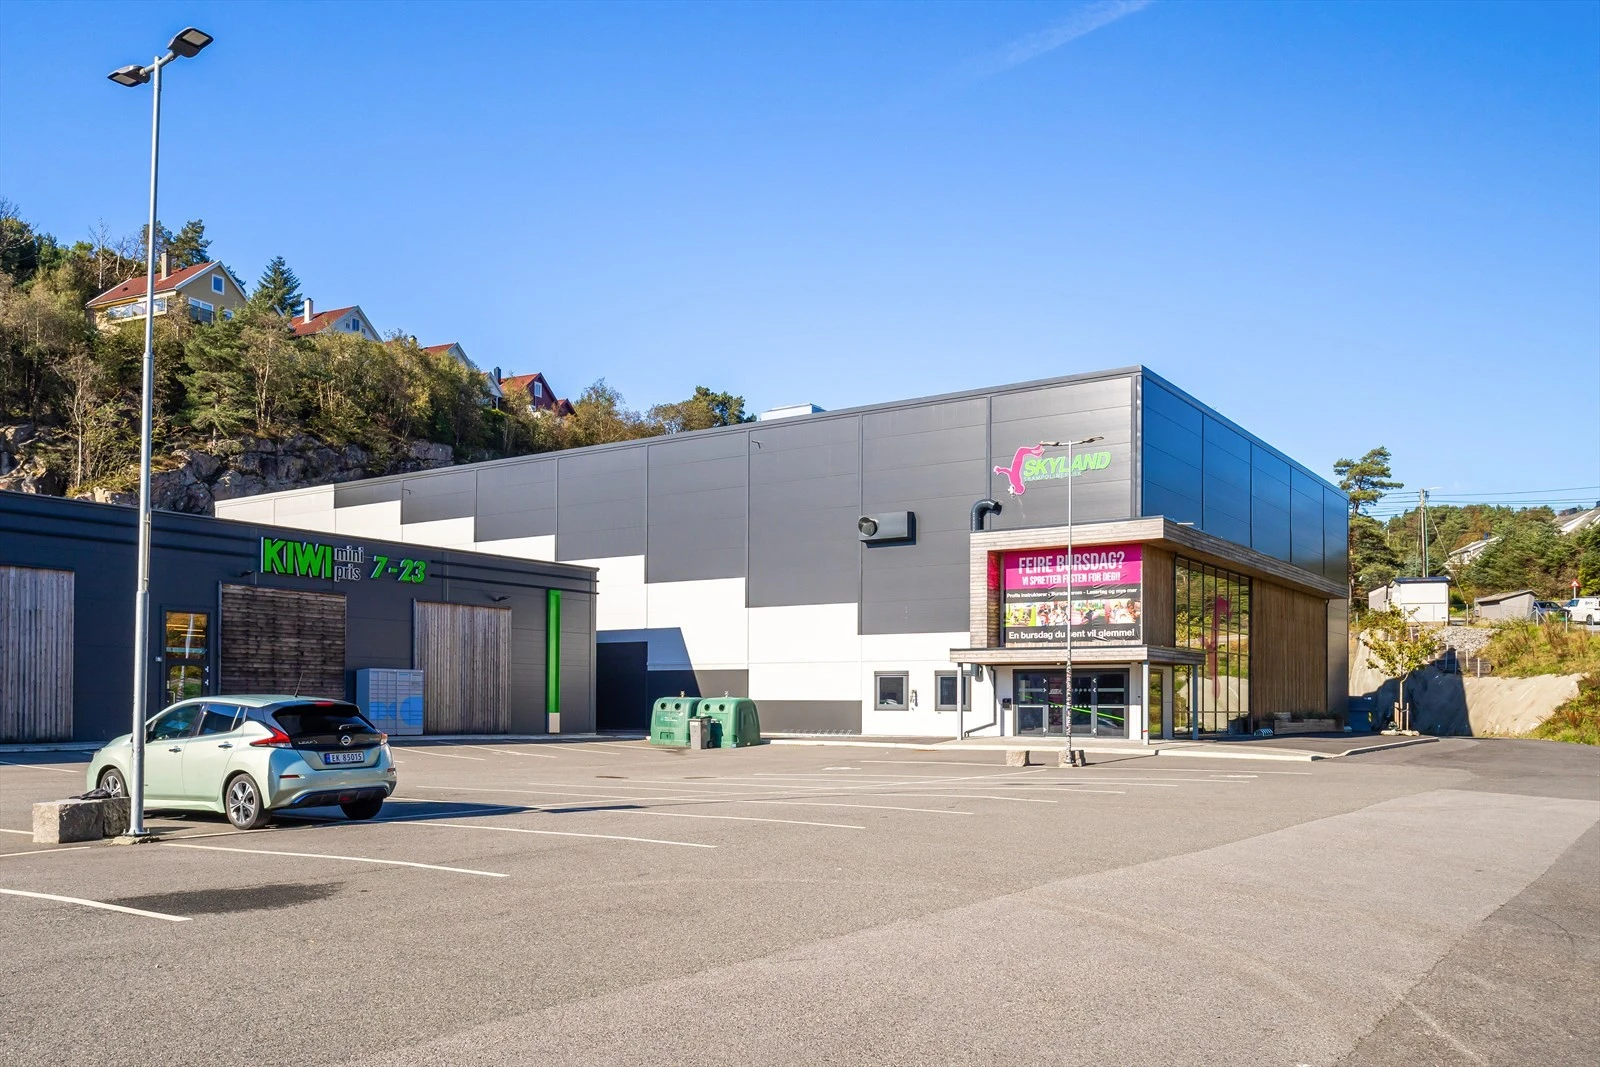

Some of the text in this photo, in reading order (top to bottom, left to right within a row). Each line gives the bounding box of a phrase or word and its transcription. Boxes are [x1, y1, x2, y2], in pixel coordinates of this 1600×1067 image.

[1024, 451, 1111, 477] SKYLAND
[1023, 470, 1082, 482] TRAMPOLINEPRK
[261, 537, 333, 580] KIWI
[334, 545, 364, 563] mini
[334, 564, 361, 582] pris
[1018, 555, 1053, 575] FEIRE
[1022, 576, 1029, 586] VI
[1030, 574, 1061, 585] SPRETTER
[1062, 573, 1087, 584] FSTEN
[1088, 572, 1102, 582] FOR
[1009, 631, 1019, 639] En
[1021, 630, 1053, 640] bursdag
[1055, 630, 1066, 638] du
[1087, 628, 1096, 638] vil
[1098, 628, 1135, 640] glemme!
[331, 754, 340, 762] EK
